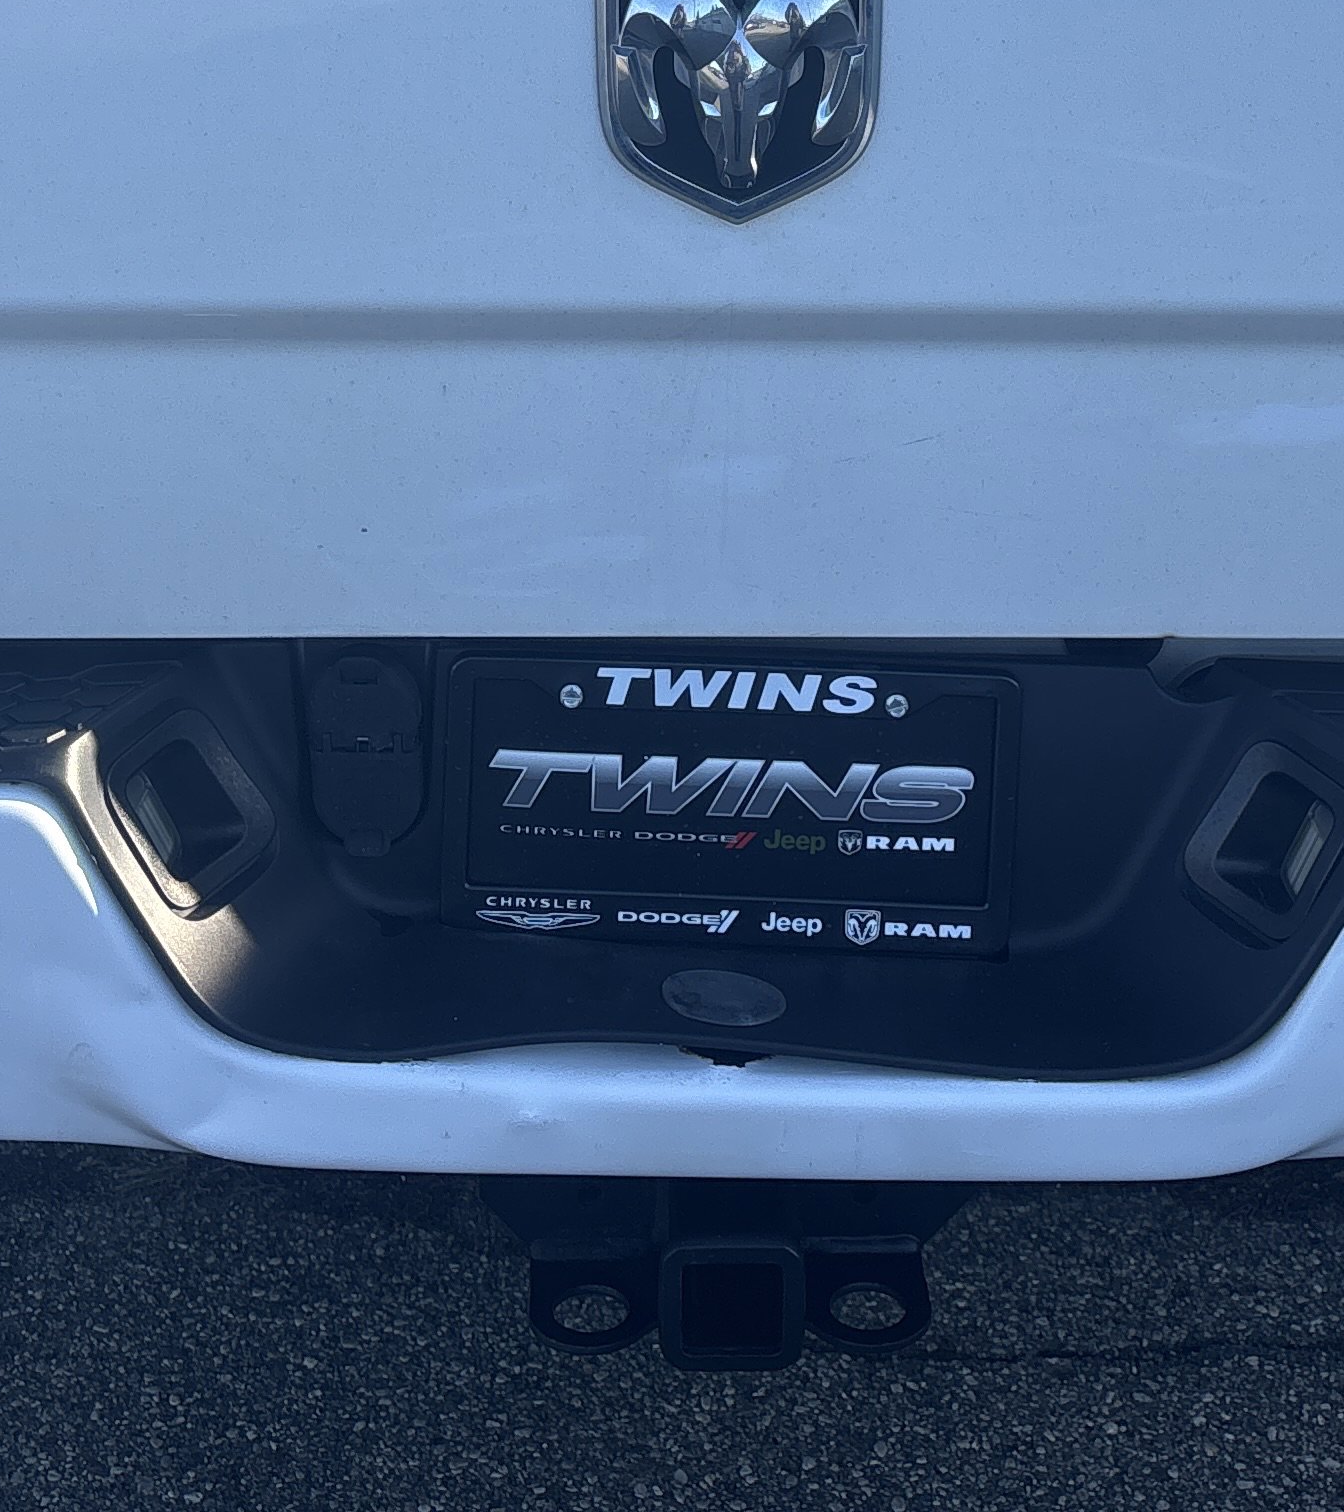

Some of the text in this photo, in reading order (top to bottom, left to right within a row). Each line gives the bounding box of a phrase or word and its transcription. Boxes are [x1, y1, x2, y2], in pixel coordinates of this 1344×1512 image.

[596, 666, 878, 714] TWINS
[488, 748, 975, 823] TWINS
[499, 824, 956, 855] CHRYSLER DODGE Jeep RAM
[485, 895, 972, 940] CHRYSLER DODGE Jeep RAM
